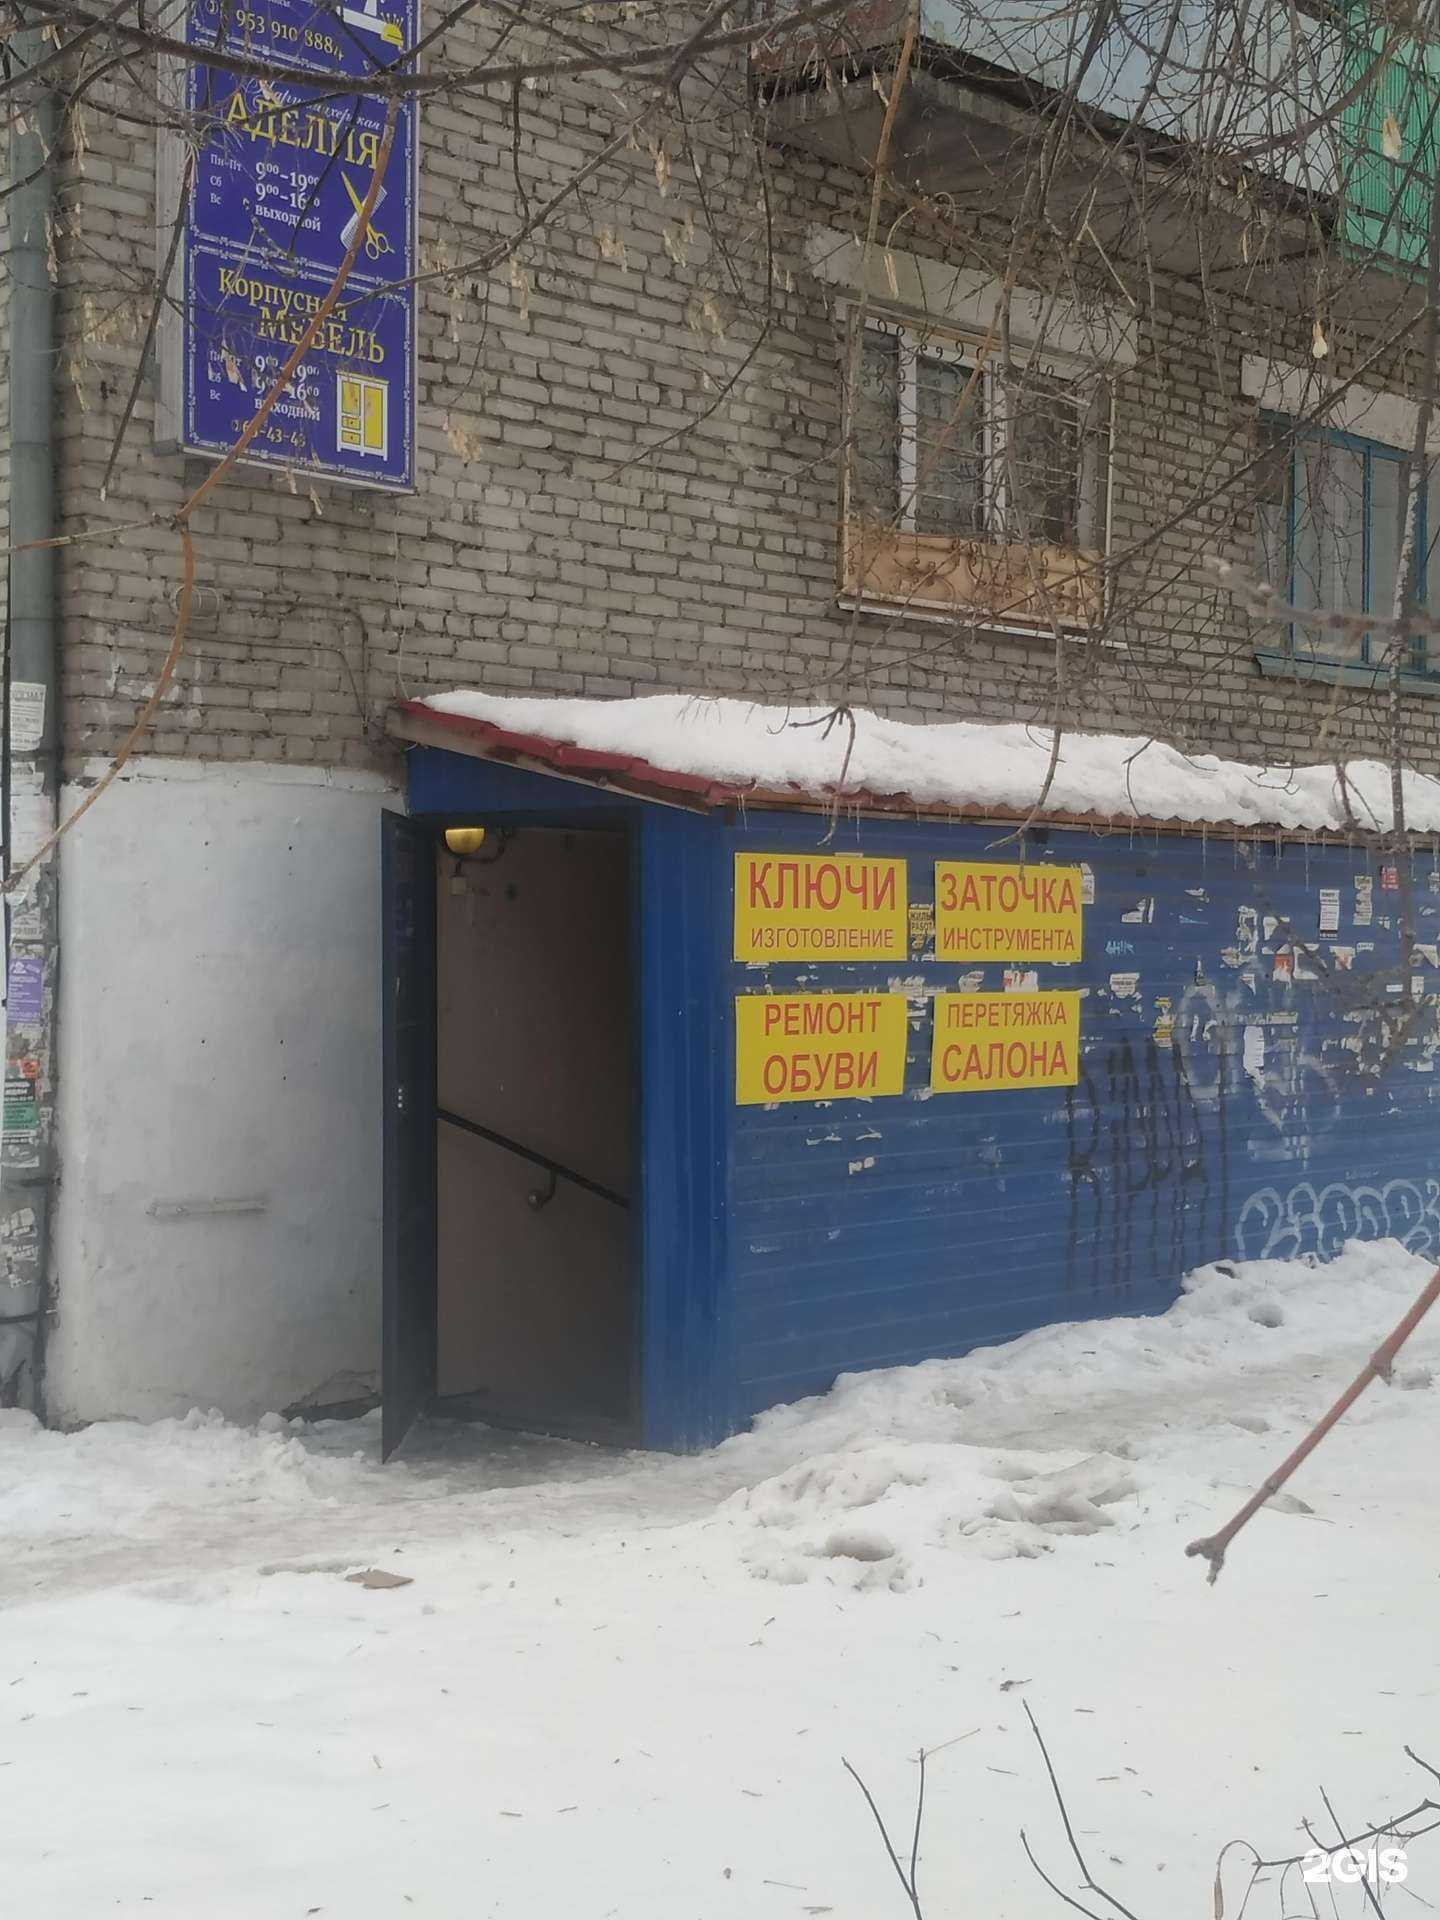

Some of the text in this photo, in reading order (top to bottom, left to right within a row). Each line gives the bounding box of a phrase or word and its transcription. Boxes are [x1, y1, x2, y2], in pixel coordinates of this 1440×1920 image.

[271, 21, 298, 42] 910
[227, 92, 380, 170] АДЕЛИЯ
[210, 175, 222, 187] Сб
[210, 192, 221, 205] Вс
[218, 267, 347, 322] Корпусня
[210, 389, 320, 422] Вс входнй
[750, 862, 896, 911] КЛЮЧИ
[940, 873, 1077, 914] ЗАТОЧКА
[751, 928, 894, 949] ИЗГОТОВЛЕНИЕ
[943, 927, 1075, 951] ИНСТРУМЕНТА
[765, 1001, 882, 1036] РЕМОНТ
[947, 1001, 1067, 1029] ПЕРЕТЯЖКА
[763, 1051, 878, 1095] ОБУВИ
[941, 1040, 1068, 1083] САЛОНА
